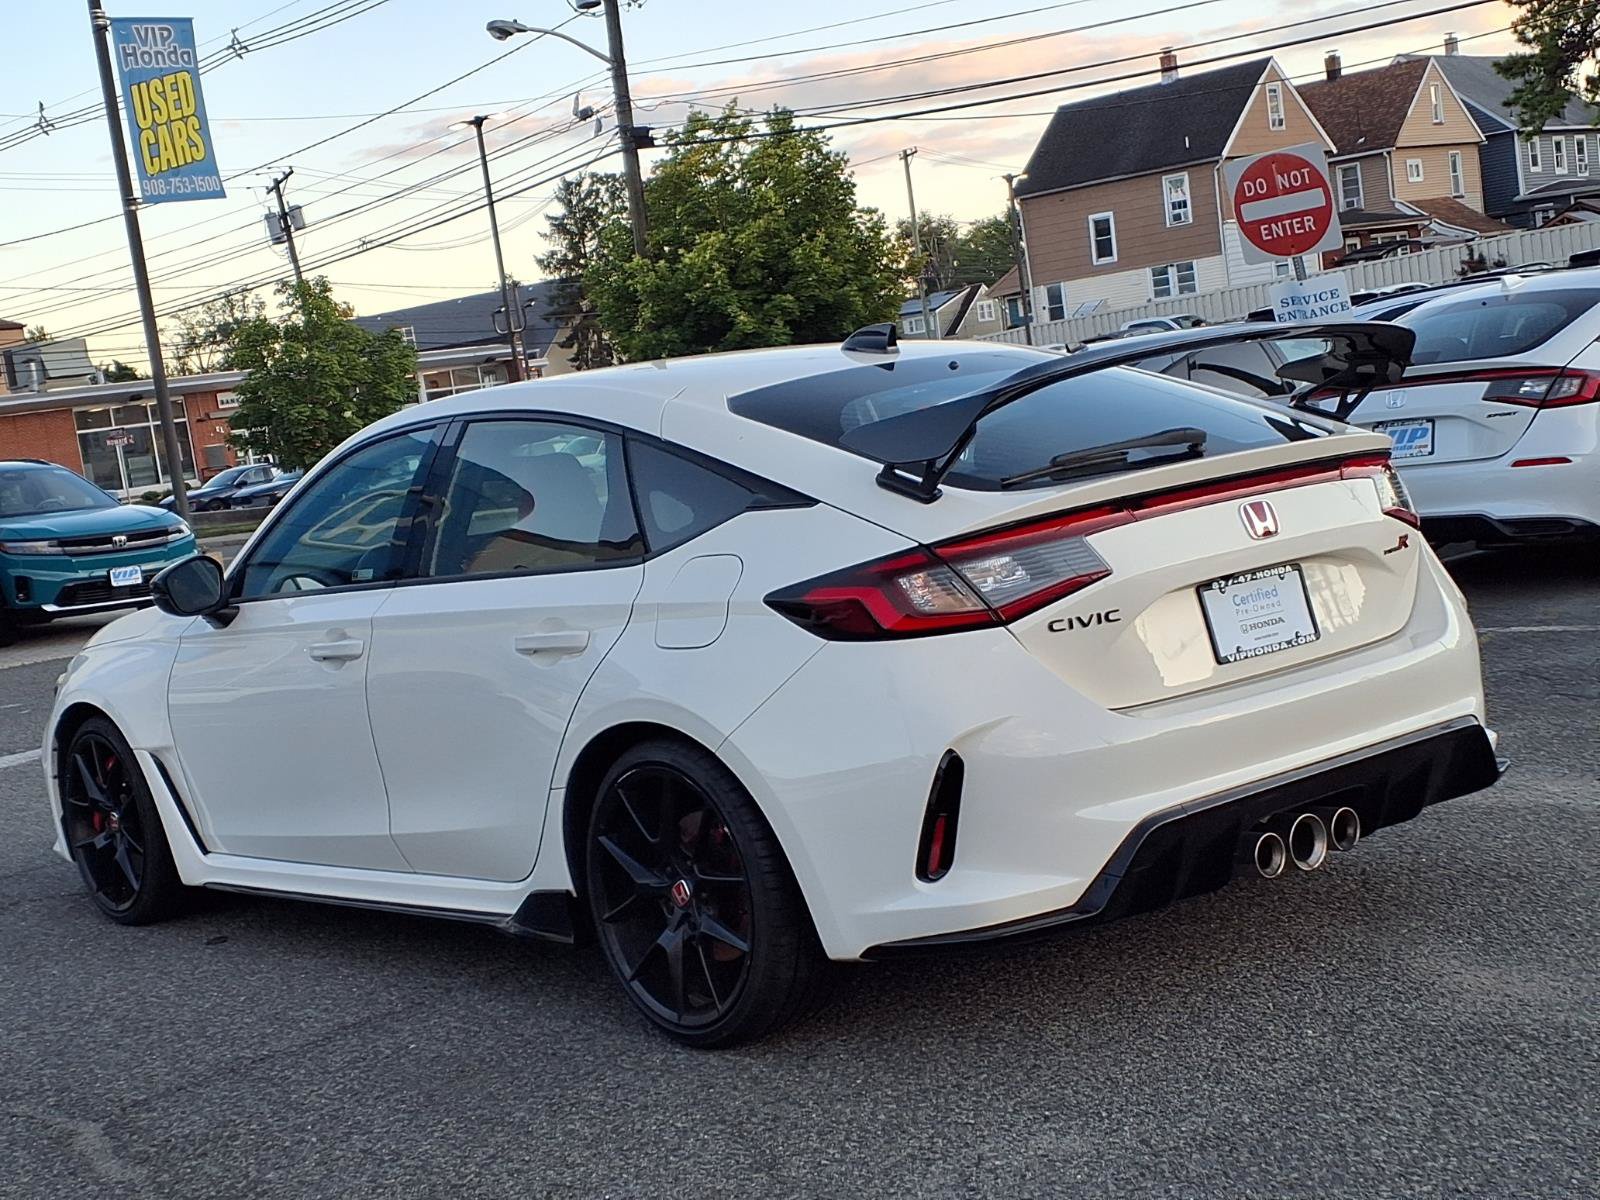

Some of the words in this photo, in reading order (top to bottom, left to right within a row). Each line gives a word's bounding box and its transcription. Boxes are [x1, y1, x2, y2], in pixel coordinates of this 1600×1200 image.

[132, 25, 174, 49] VIP
[119, 44, 194, 71] Honda
[130, 70, 196, 129] USED
[139, 115, 206, 177] CARS
[143, 175, 221, 196] 908-753-1500
[1243, 178, 1267, 197] DO
[1276, 168, 1311, 190] NOT
[1260, 215, 1316, 241] ENTER
[112, 568, 139, 579] VIP
[1232, 585, 1279, 607] Certified
[1047, 608, 1122, 633] CIVIC
[1248, 616, 1286, 631] HONDA
[1226, 633, 1316, 662] VIPHONDA.COM
